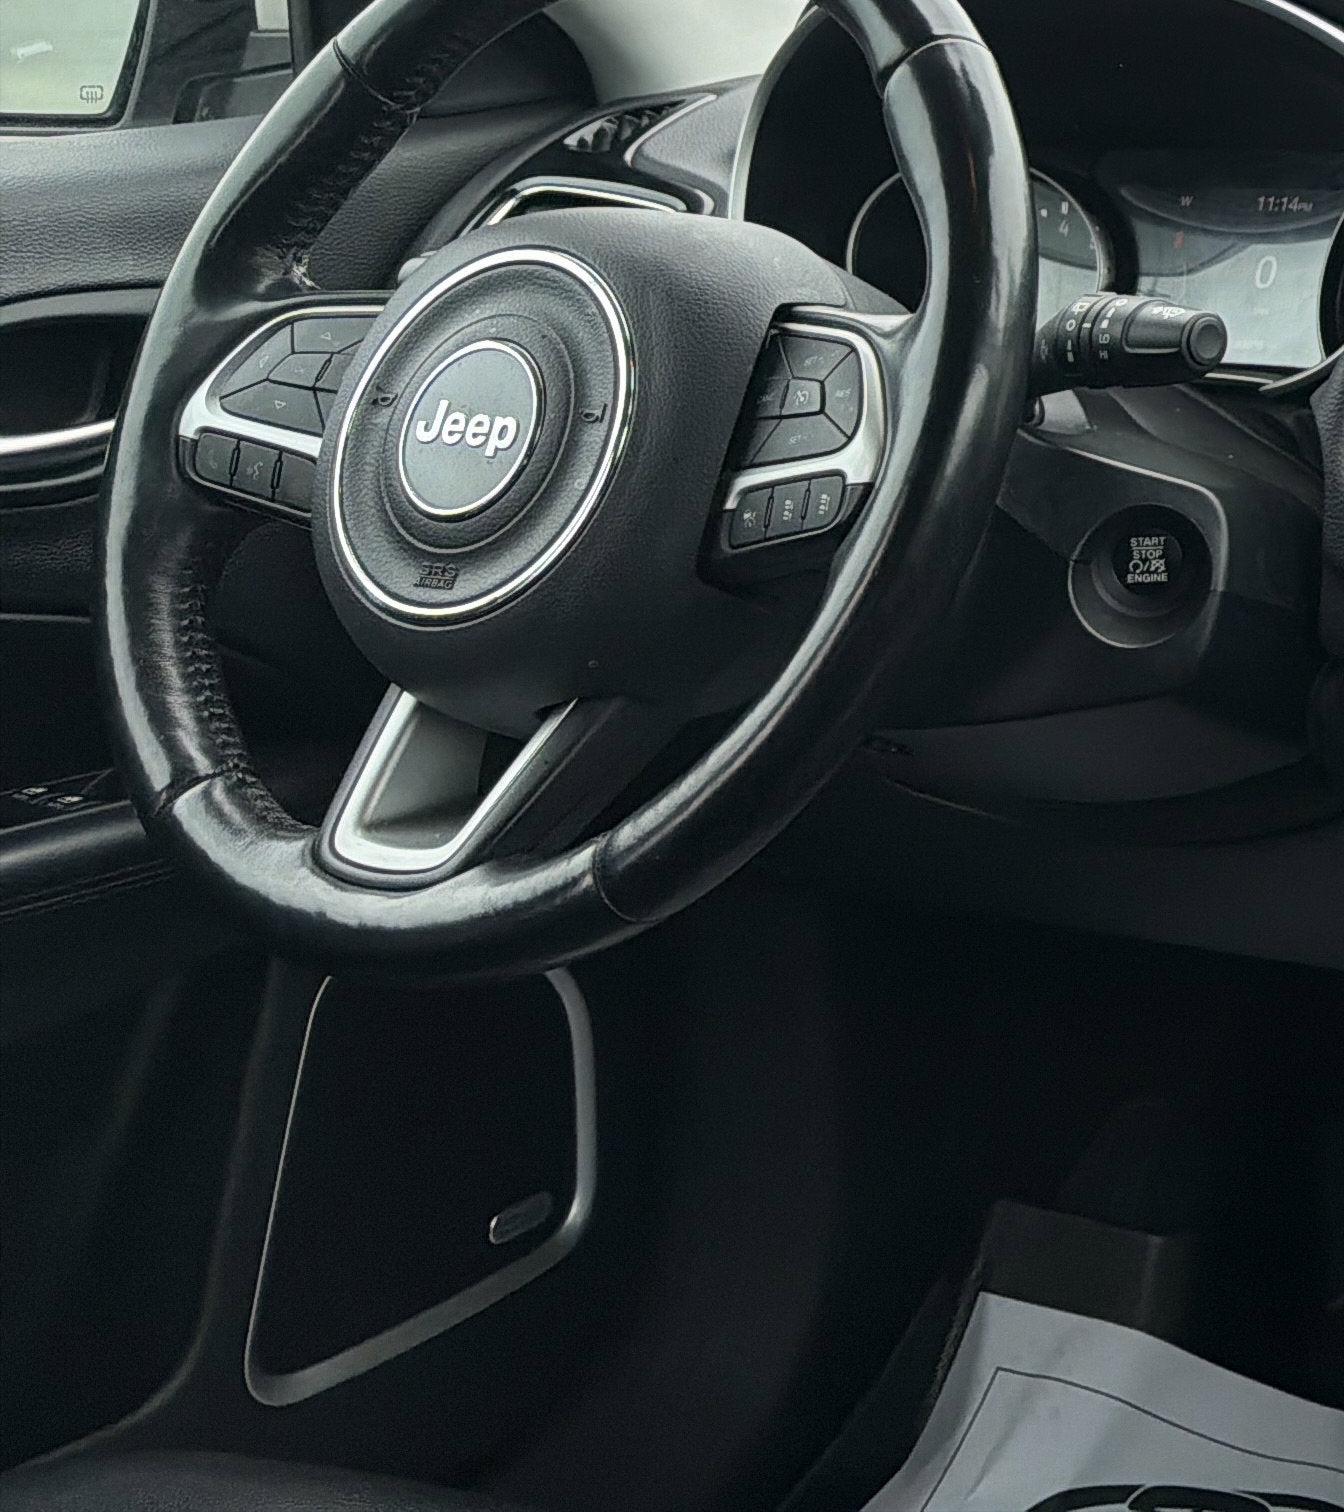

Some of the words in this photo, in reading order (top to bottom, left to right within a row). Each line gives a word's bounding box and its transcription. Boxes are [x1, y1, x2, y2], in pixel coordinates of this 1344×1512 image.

[1254, 255, 1278, 288] 0
[415, 398, 521, 459] Jeep
[1130, 536, 1166, 547] START
[1132, 549, 1164, 560] STOP
[1127, 572, 1168, 584] ENGINE
